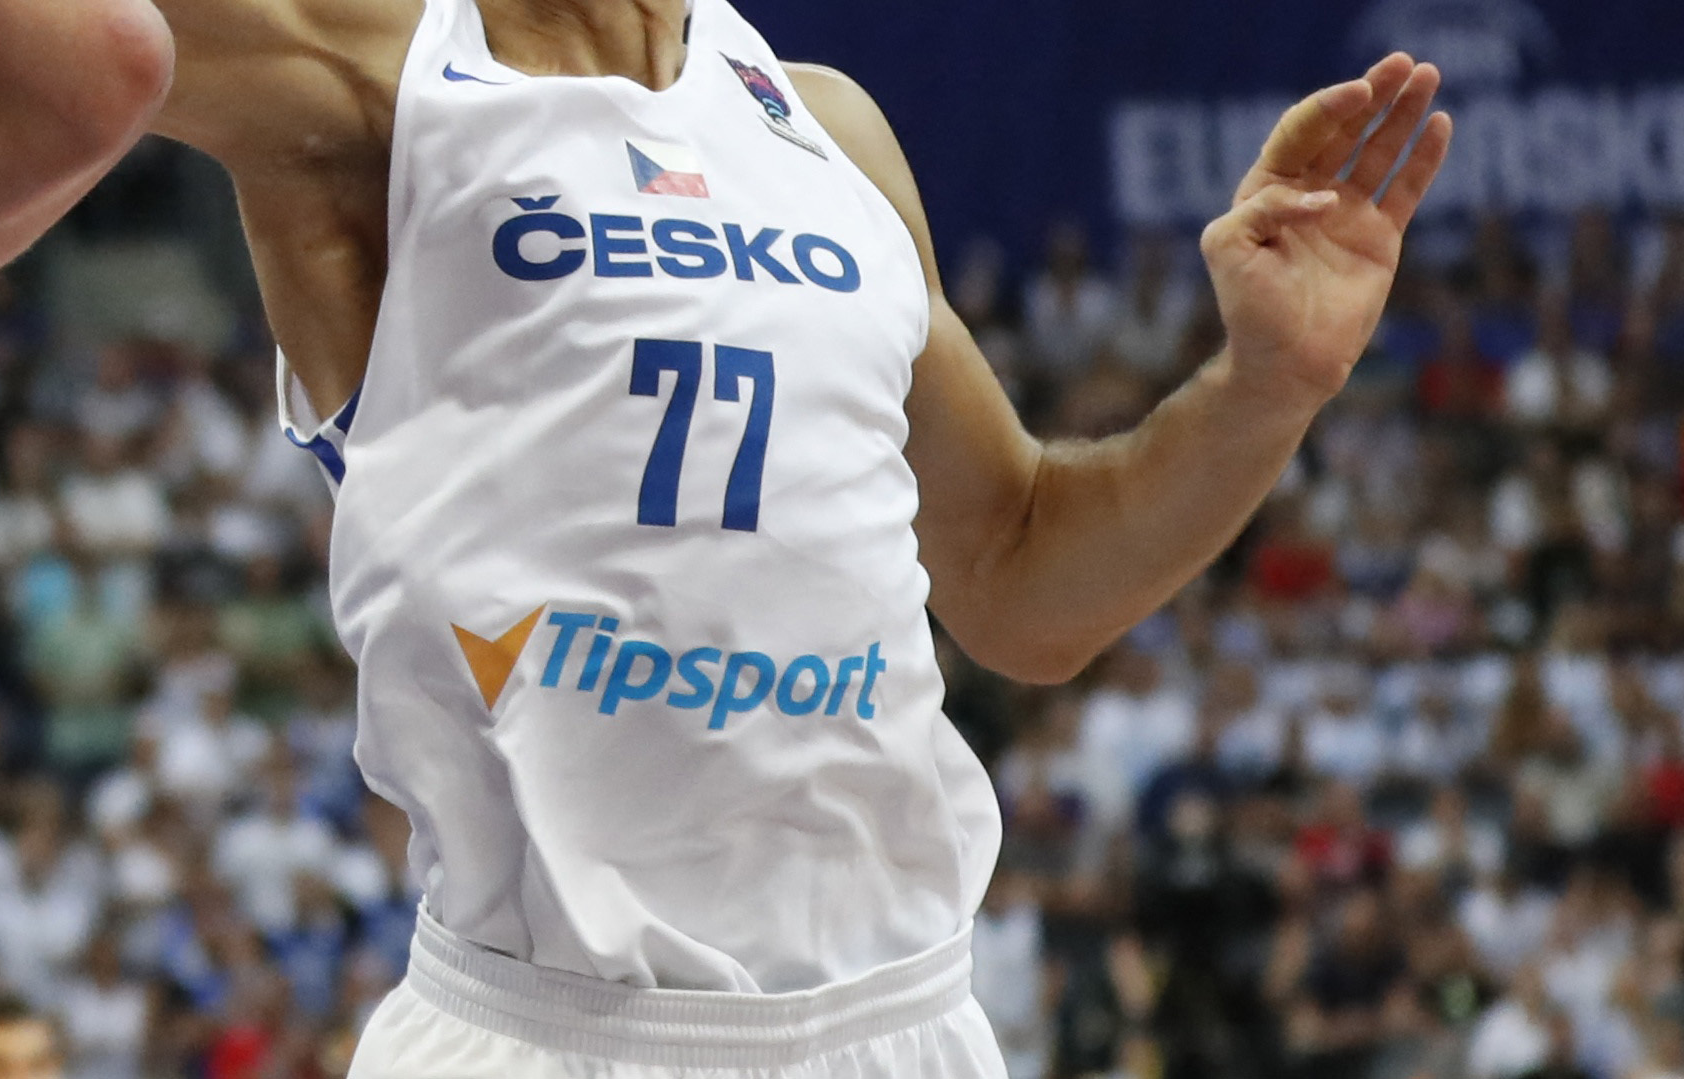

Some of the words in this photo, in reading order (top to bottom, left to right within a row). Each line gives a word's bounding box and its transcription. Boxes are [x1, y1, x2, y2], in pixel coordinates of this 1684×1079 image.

[492, 195, 861, 293] ČESKO
[629, 338, 775, 532] 77
[539, 612, 886, 731] Tipsport
